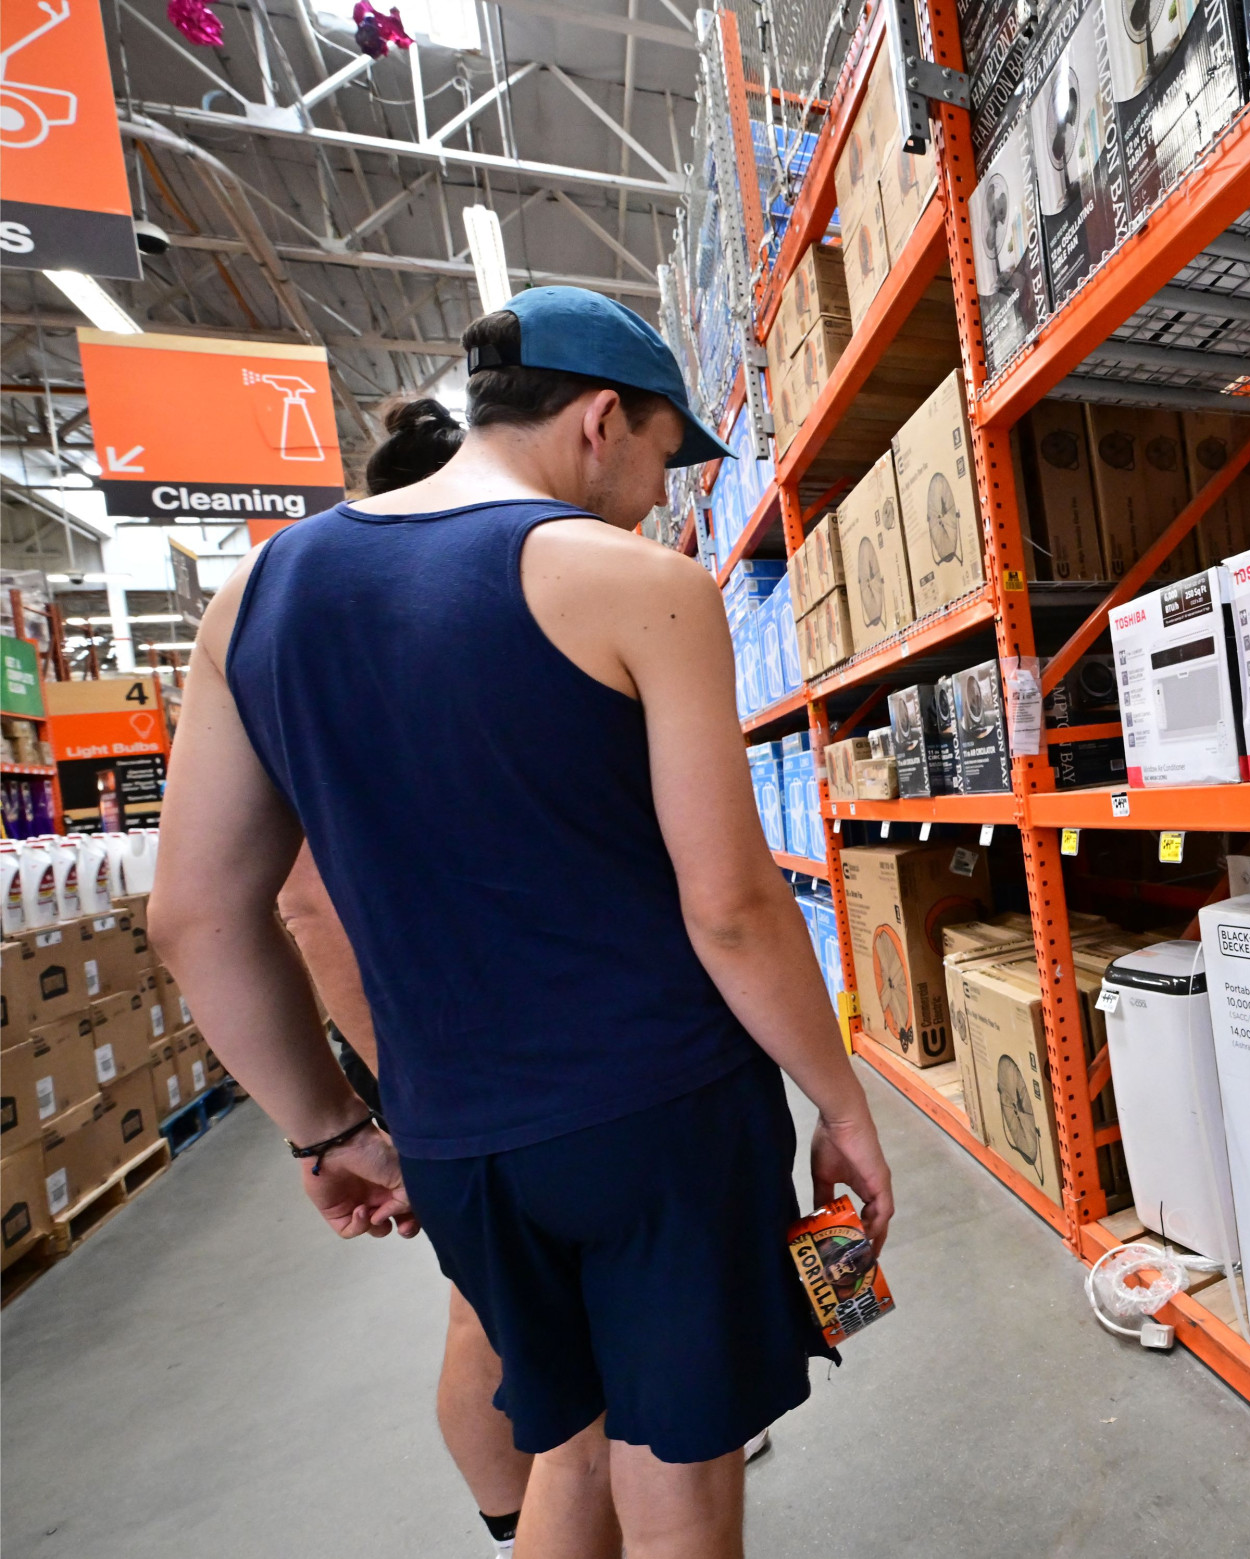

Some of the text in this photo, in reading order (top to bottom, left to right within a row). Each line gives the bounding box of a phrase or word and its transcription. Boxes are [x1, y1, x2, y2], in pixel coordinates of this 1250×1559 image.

[971, 27, 1010, 109] HAMPTON
[1025, 6, 1080, 98] HAMPTON
[972, 71, 1014, 148] HAMPTON
[1092, 3, 1129, 240] HAMPTON BAY
[1127, 139, 1147, 171] TABLE
[1019, 127, 1047, 324] HAMPTON BAY
[1061, 199, 1095, 248] OSCILLATING
[1052, 249, 1067, 273] TABLE
[1067, 235, 1078, 255] FAN
[152, 485, 305, 518] Cleaning
[1115, 609, 1147, 631] TOSHIBA
[126, 682, 149, 706] 4
[66, 742, 159, 759] Light Bulbs
[989, 668, 1009, 788] HAMPTON BAY
[1060, 752, 1076, 783] BAY
[797, 1245, 837, 1318] GORILLA
